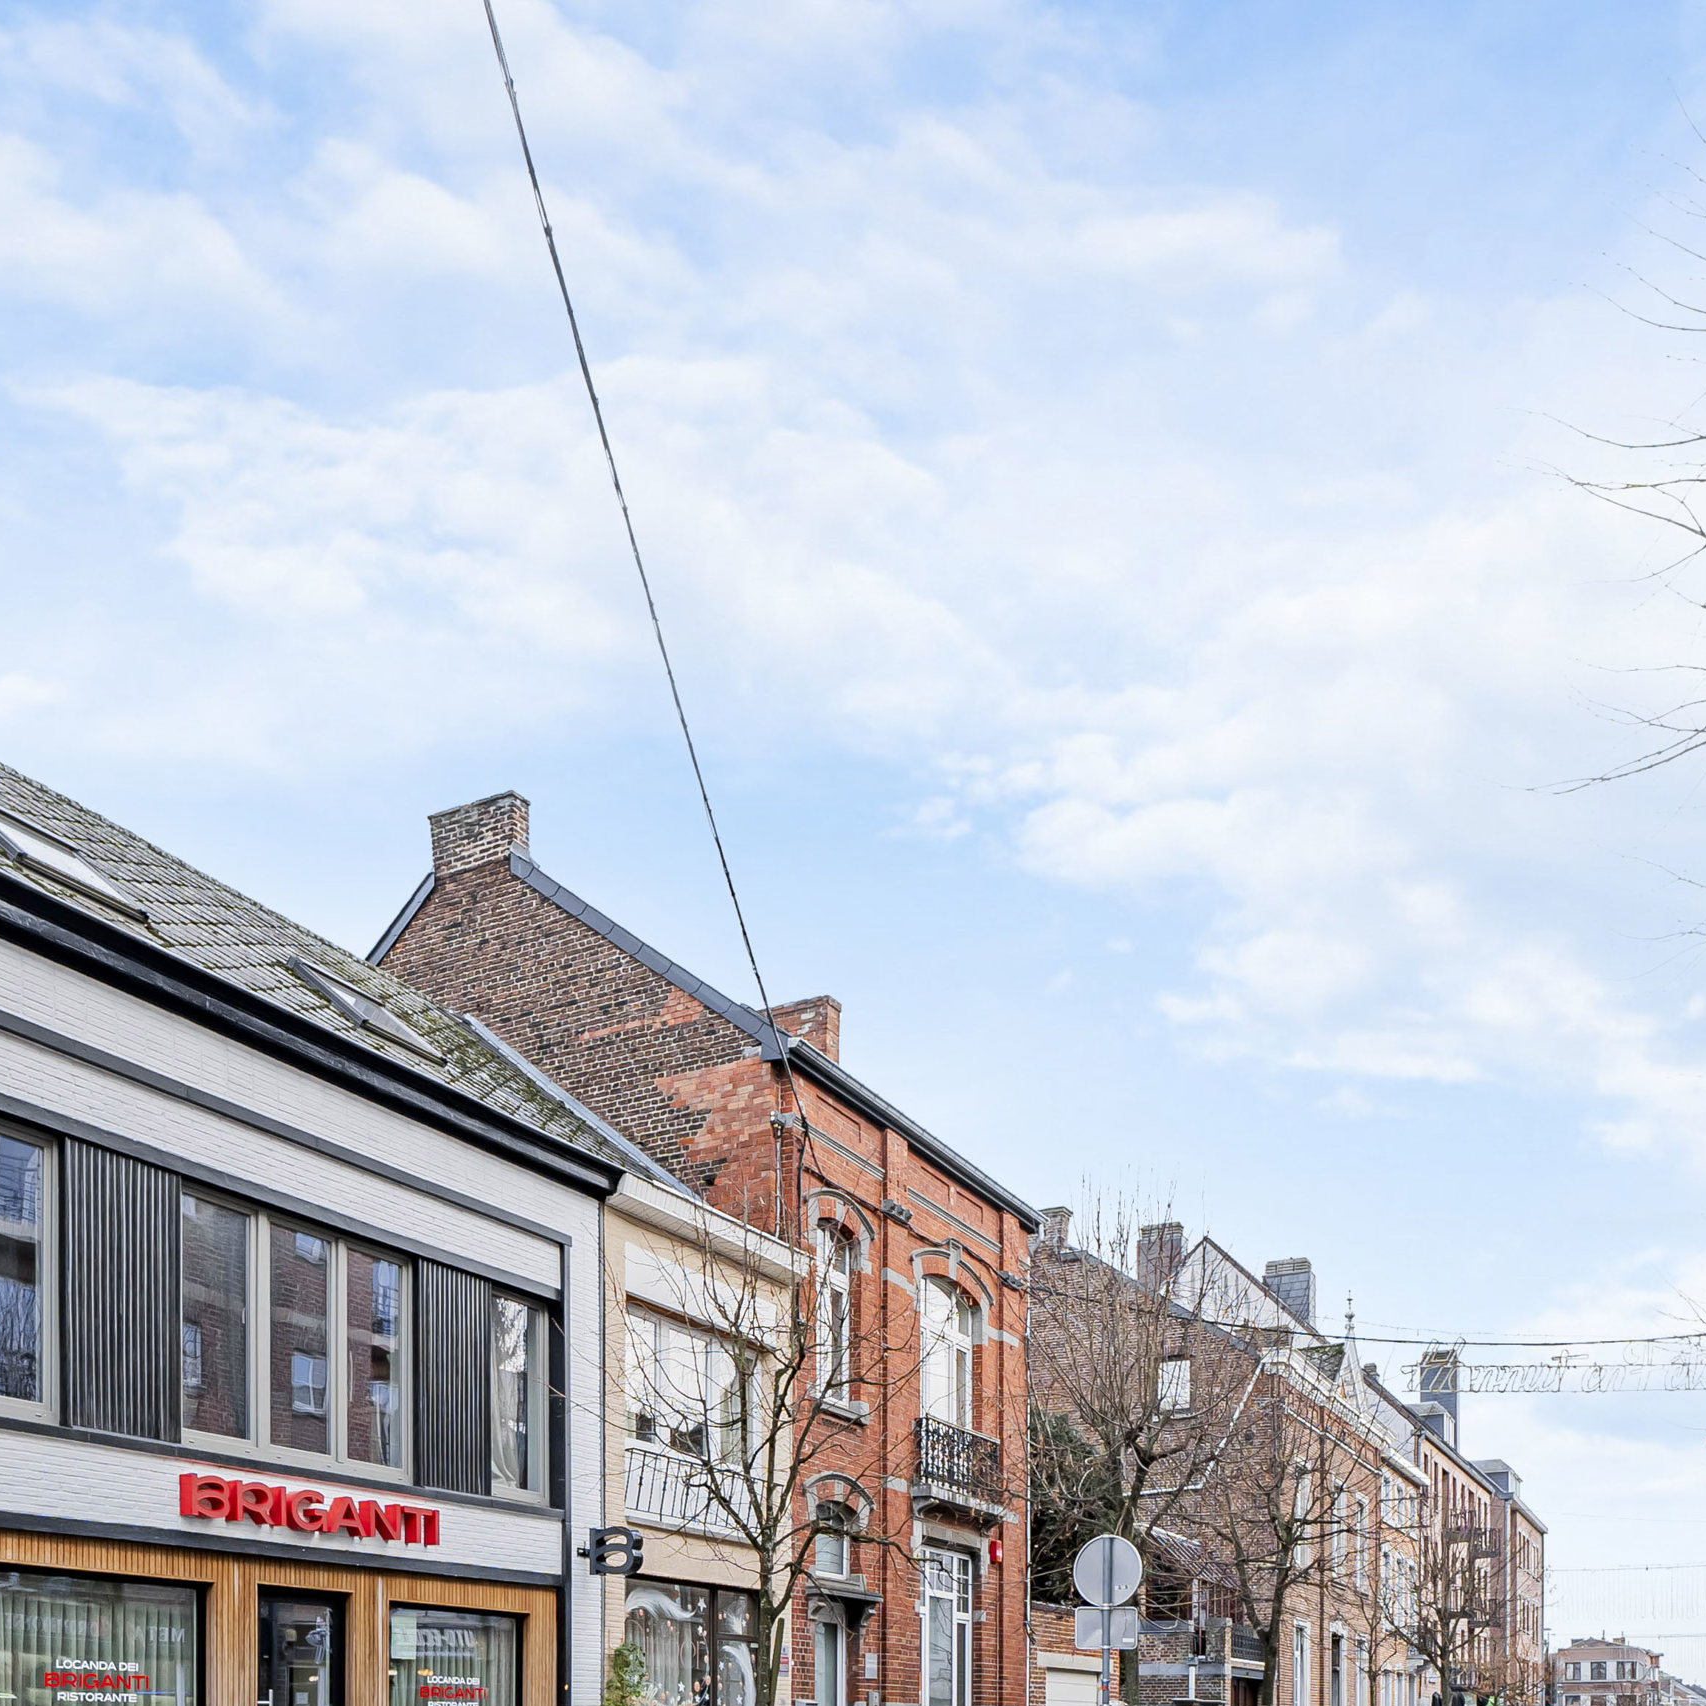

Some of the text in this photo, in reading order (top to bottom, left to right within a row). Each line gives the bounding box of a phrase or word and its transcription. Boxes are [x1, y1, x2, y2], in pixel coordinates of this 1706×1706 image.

[179, 1472, 440, 1546] BRIGANTI
[55, 1659, 139, 1672] LOCANDA DEI
[43, 1671, 150, 1691] BRIGANTI
[426, 1675, 481, 1686] LOCANDA DEI
[56, 1691, 138, 1703] RISTORANTE
[419, 1686, 488, 1700] BRIGANTI
